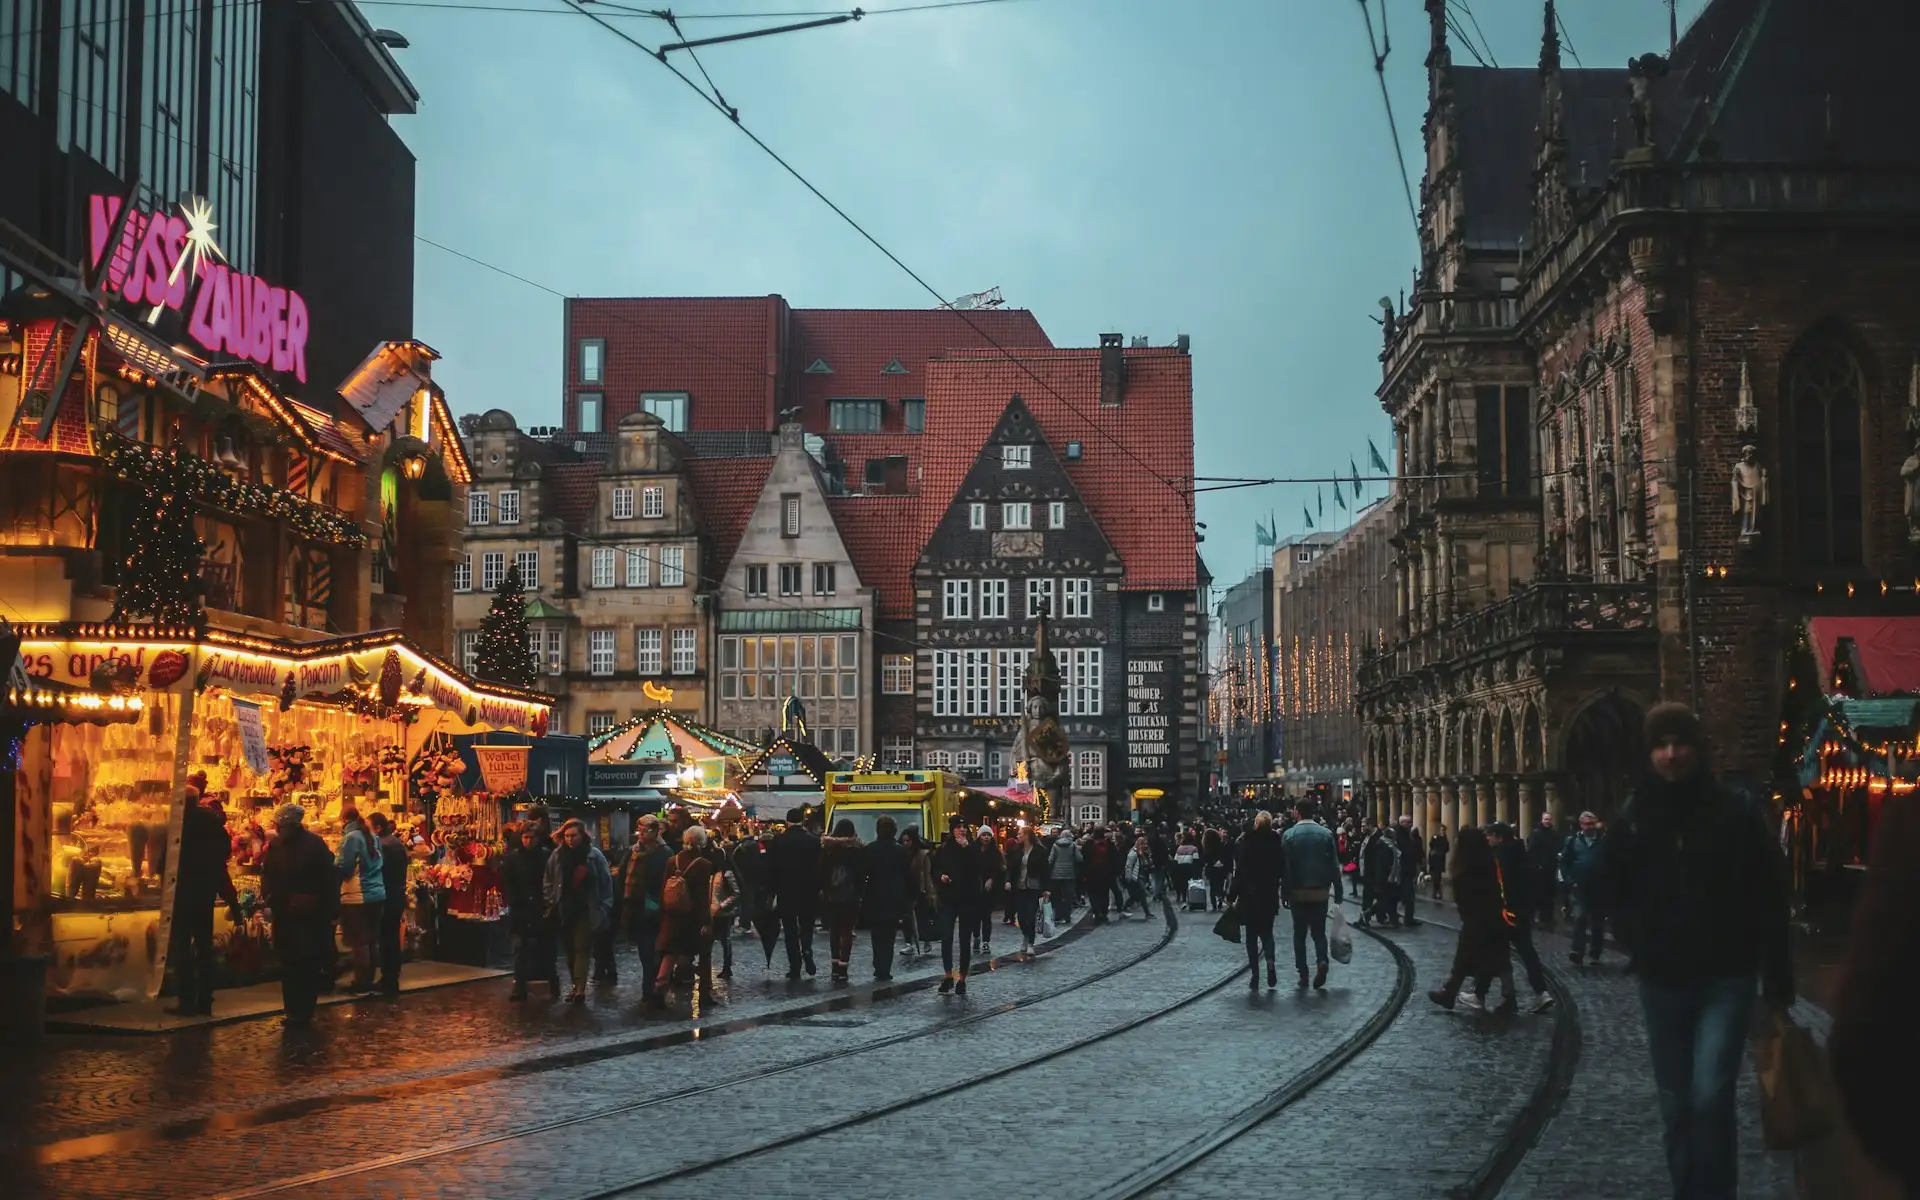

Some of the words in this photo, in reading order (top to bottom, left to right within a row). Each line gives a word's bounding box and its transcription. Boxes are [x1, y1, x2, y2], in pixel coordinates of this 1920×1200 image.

[187, 259, 310, 384] ZAUBER
[1128, 660, 1164, 673] GEDENKE
[299, 662, 341, 690] Popcorn
[1128, 674, 1144, 686] DER
[429, 676, 462, 713] Mandeln
[1128, 702, 1141, 713] DIE
[1128, 715, 1170, 727] SCHICKSAL
[1128, 729, 1164, 741] UNSERER
[1128, 743, 1170, 754] TRENNUNG
[594, 770, 638, 780] Souvenirs
